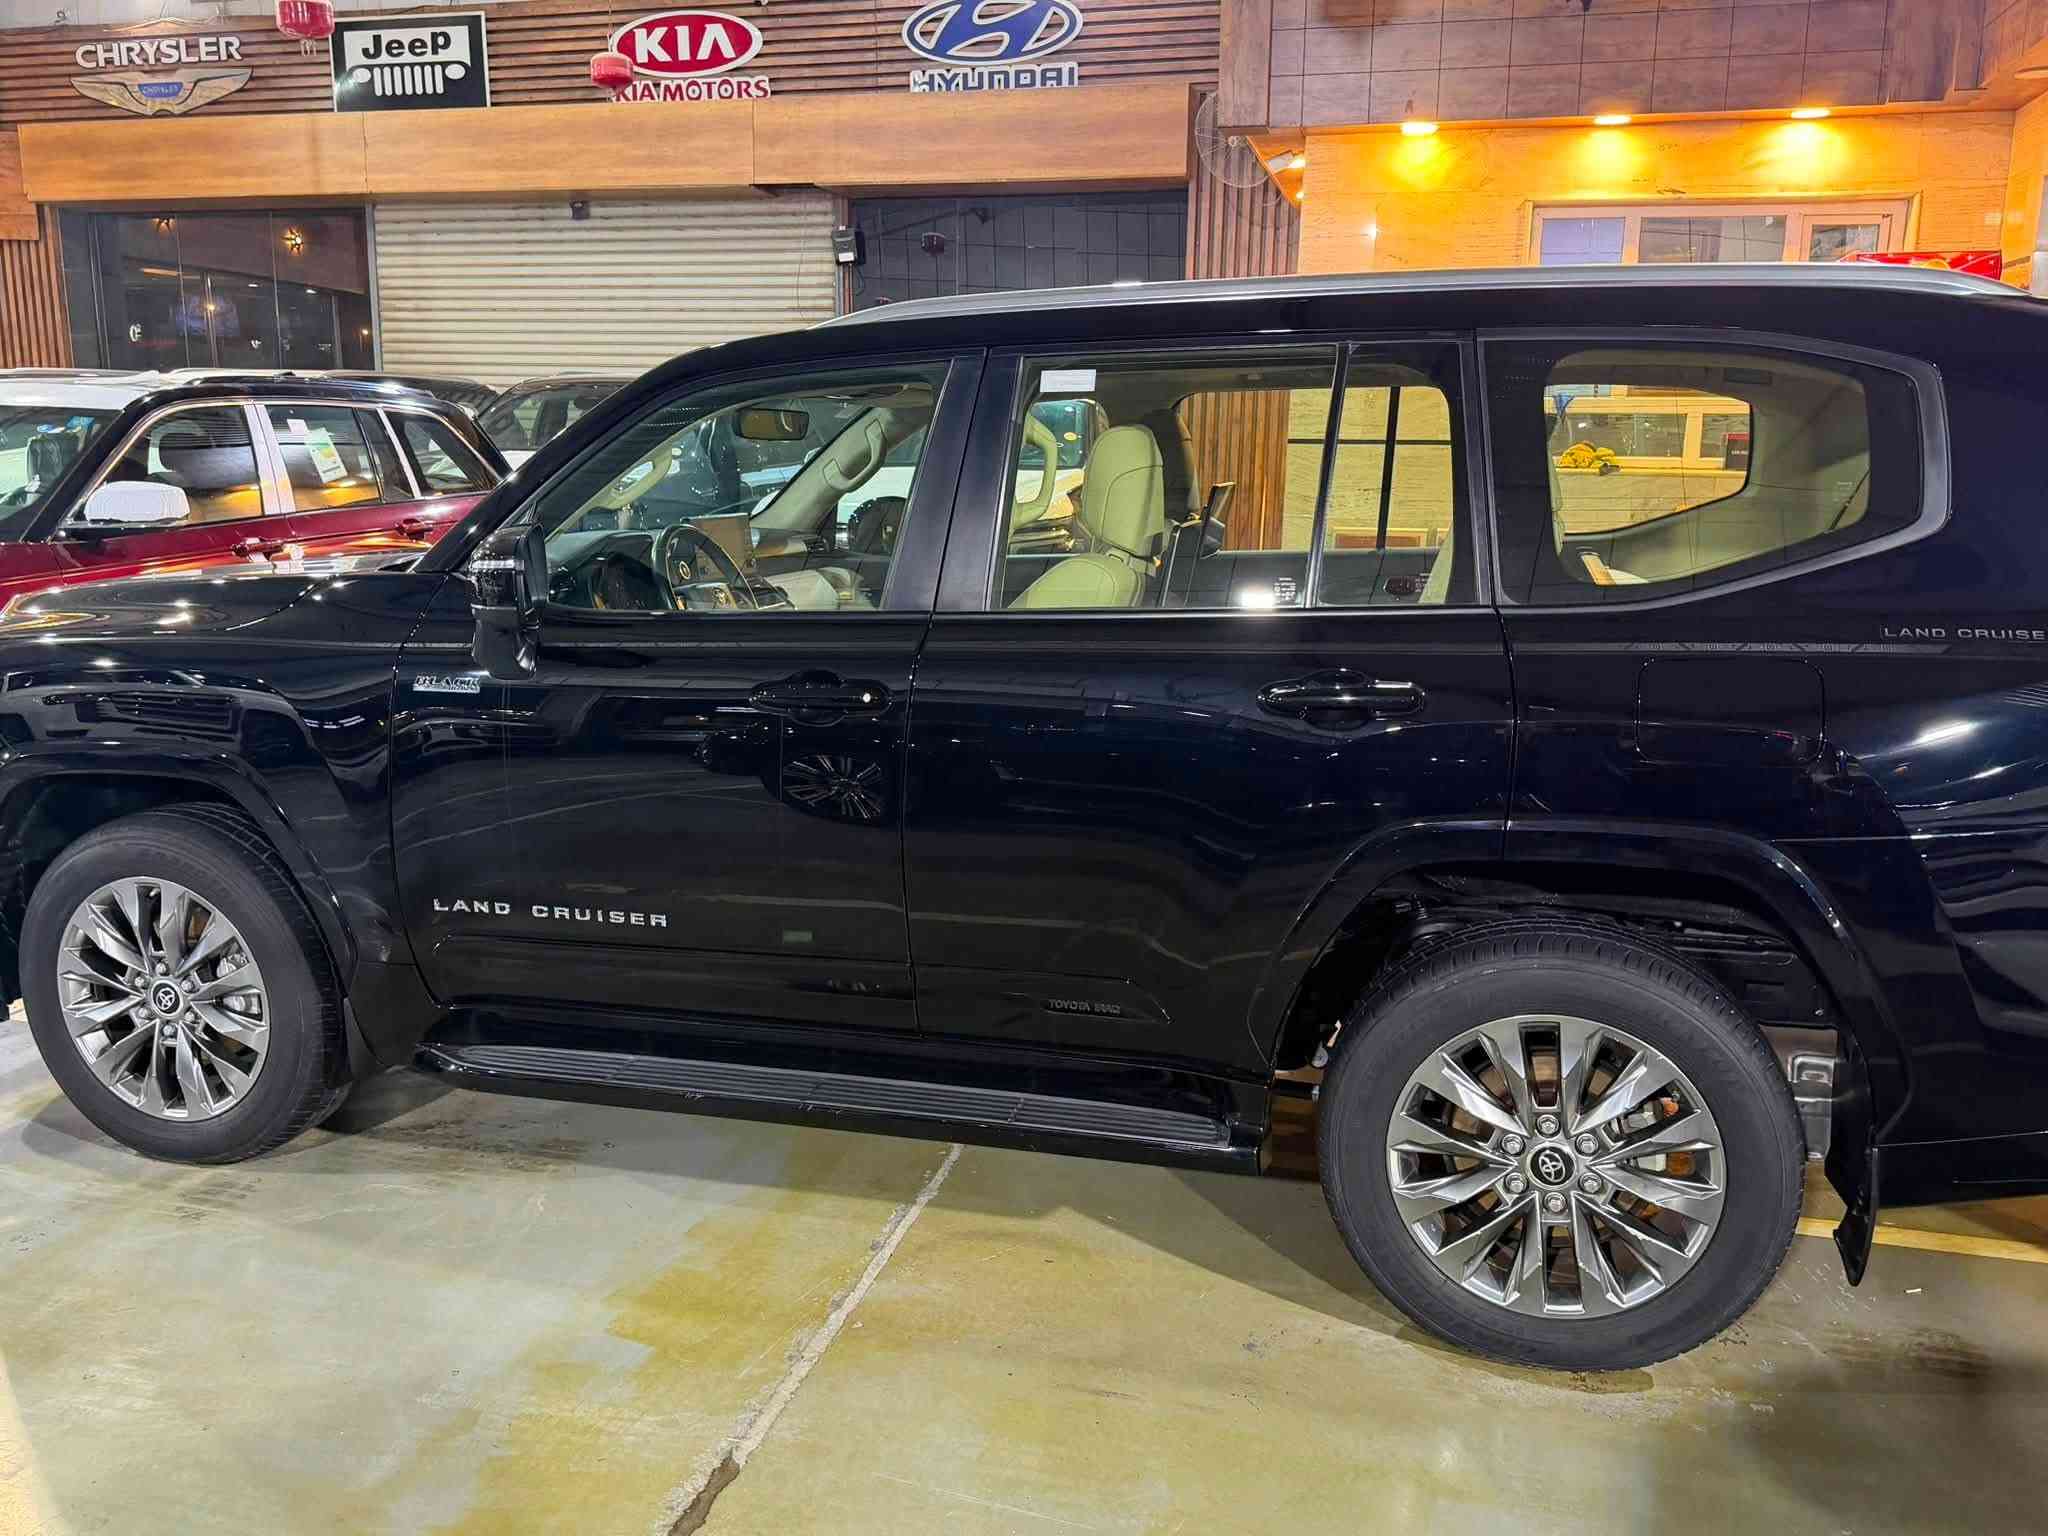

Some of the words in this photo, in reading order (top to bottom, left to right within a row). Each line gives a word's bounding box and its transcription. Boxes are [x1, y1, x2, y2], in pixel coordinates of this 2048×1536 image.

[75, 36, 242, 69] CHRYSLER
[361, 31, 451, 60] Jeep
[633, 23, 737, 64] KIA
[614, 81, 657, 102] KIA
[661, 77, 770, 101] MOTORS
[912, 63, 1078, 92] HYUNDAI
[1884, 627, 1946, 639] LAND
[433, 898, 511, 916] LAND
[532, 904, 668, 928] CRUISER
[1047, 999, 1090, 1012] TOYOTA
